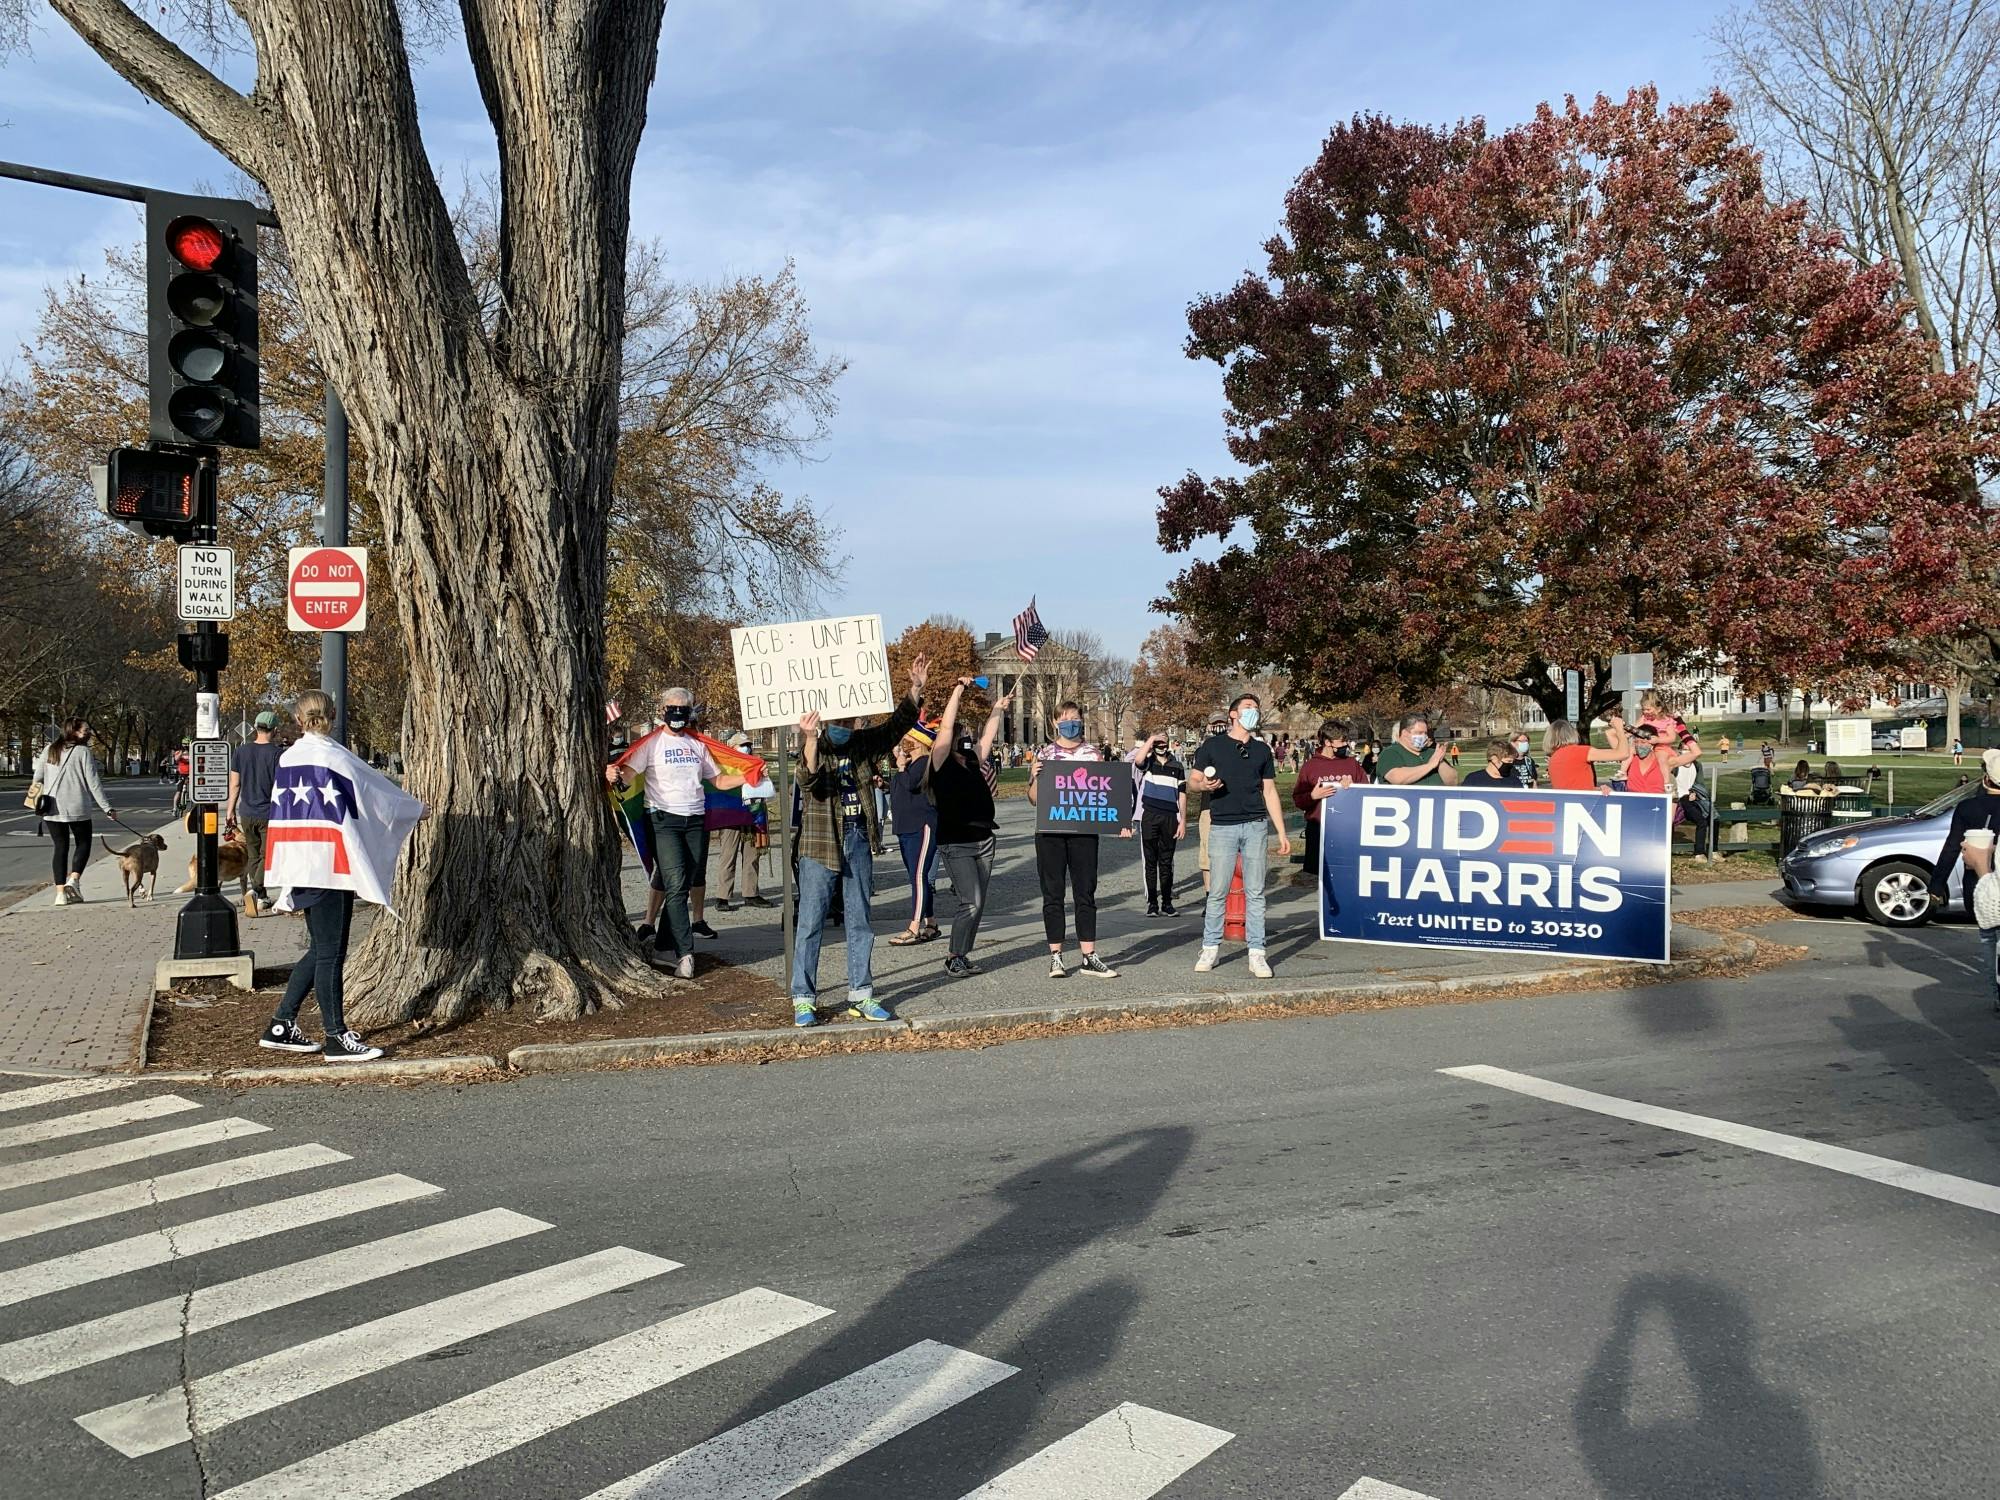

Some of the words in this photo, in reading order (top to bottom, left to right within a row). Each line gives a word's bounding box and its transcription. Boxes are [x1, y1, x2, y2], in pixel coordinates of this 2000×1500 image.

[195, 551, 217, 563] NO
[191, 566, 222, 576] TURN
[301, 565, 319, 578] DO
[328, 564, 354, 578] NOT
[184, 578, 227, 590] DURING
[189, 592, 223, 602] WALK
[184, 604, 227, 616] SIGNAL
[305, 601, 348, 614] ENTER
[811, 619, 876, 650] UNFIT
[745, 661, 773, 687] TO
[787, 654, 844, 683] RULE
[856, 650, 883, 676] ON
[746, 687, 828, 720] ELECTION
[838, 679, 887, 709] CASES
[664, 748, 698, 758] BIDEN
[665, 756, 700, 765] HARRIS
[1059, 790, 1108, 806] LIVES
[1048, 806, 1119, 822] MATTER
[1360, 796, 1622, 857] BIDEN
[1358, 855, 1623, 913] HARRIS
[1377, 912, 1414, 927] Text
[1417, 913, 1503, 932] UNITED
[1508, 921, 1526, 934] to
[1531, 921, 1603, 939] 30330
